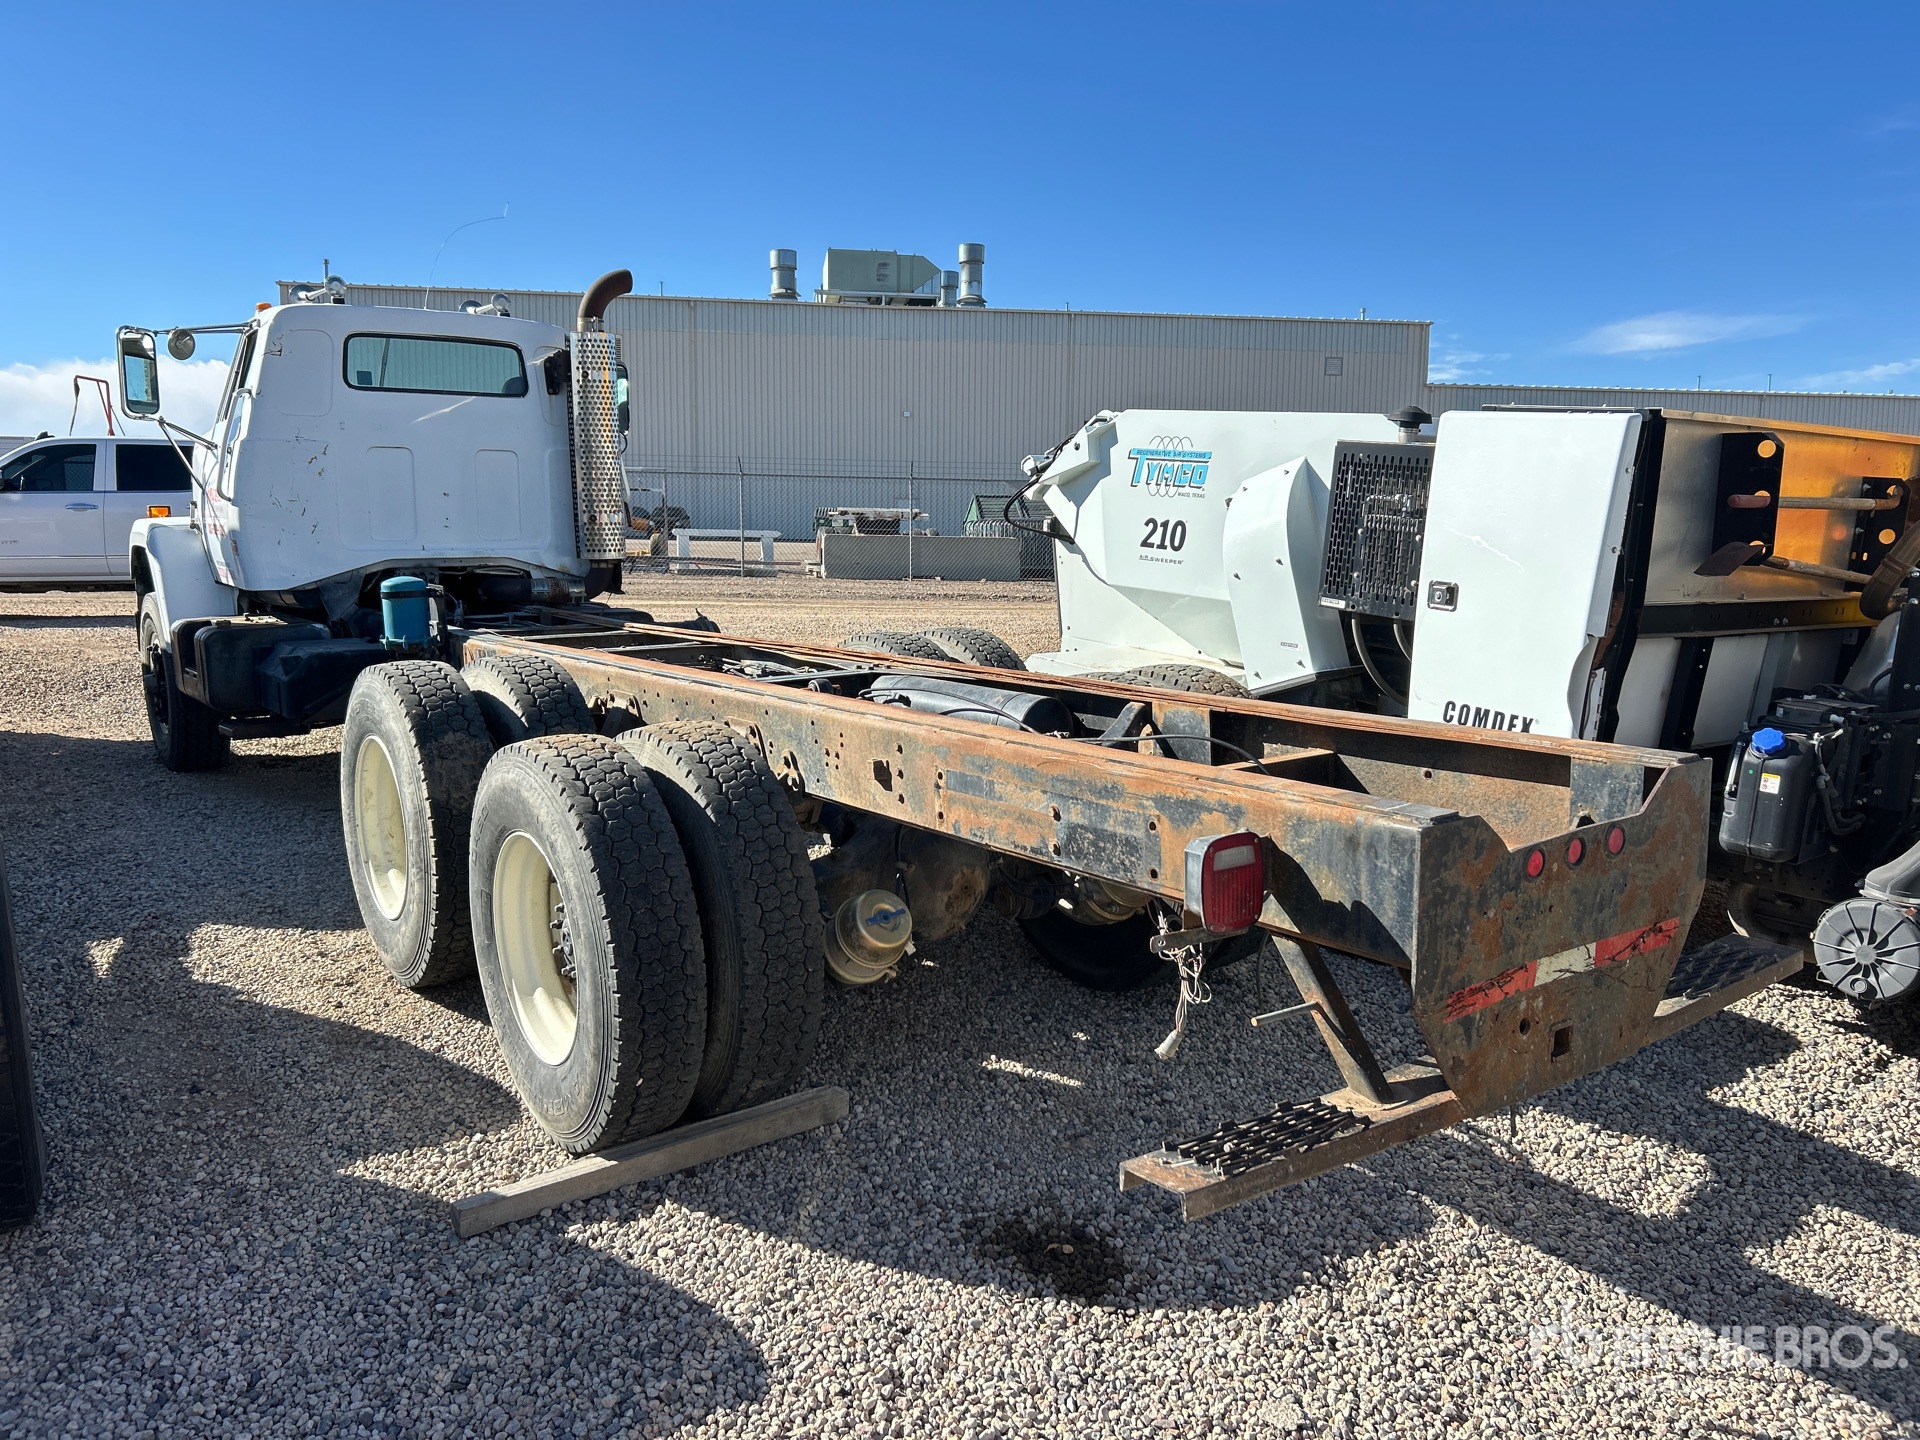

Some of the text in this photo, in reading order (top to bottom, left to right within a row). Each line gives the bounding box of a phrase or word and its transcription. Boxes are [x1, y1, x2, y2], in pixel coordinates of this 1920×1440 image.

[1128, 448, 1212, 489] TYMCO
[1136, 449, 1171, 457] REGENERATIVE
[1182, 451, 1207, 459] SYSTEMS
[1140, 517, 1187, 552] 210
[1150, 556, 1182, 565] SWEEPER
[1442, 700, 1535, 734] COMDEX
